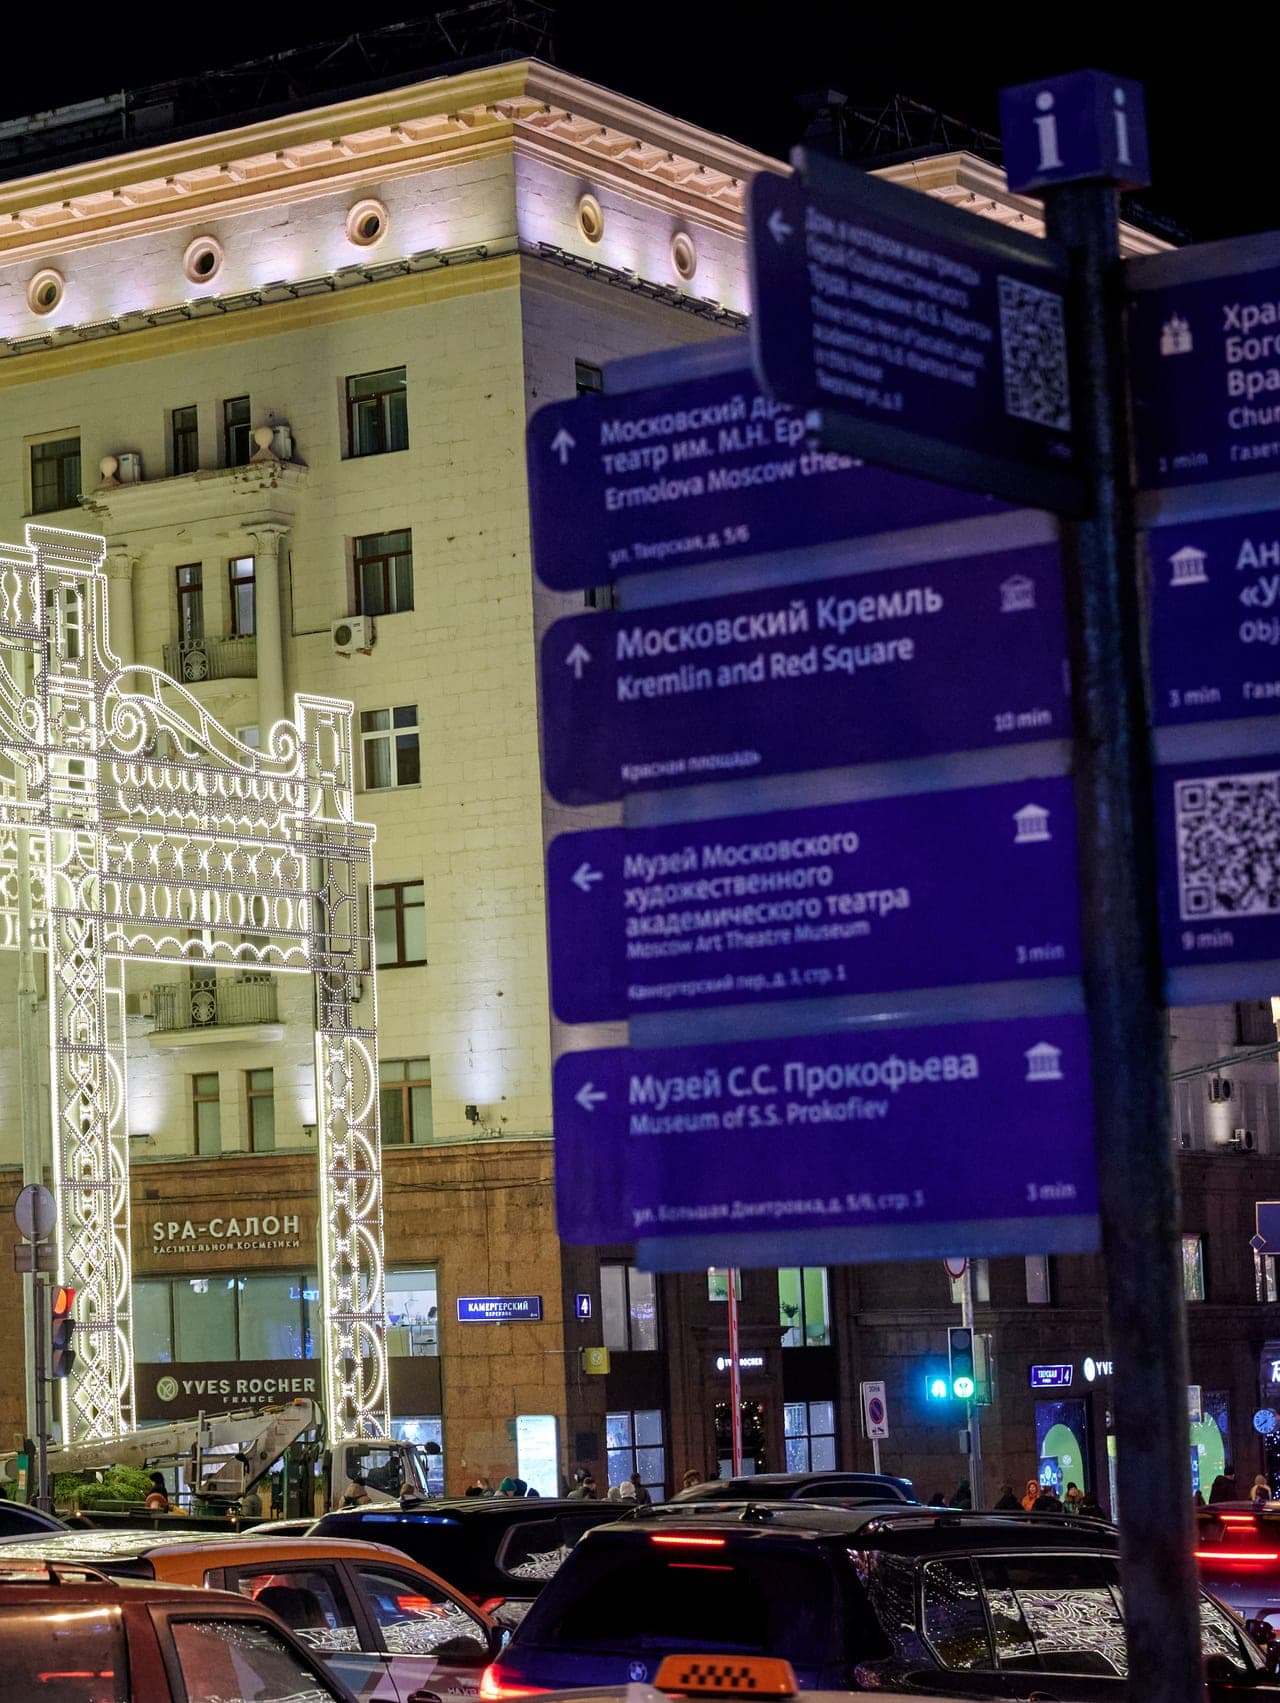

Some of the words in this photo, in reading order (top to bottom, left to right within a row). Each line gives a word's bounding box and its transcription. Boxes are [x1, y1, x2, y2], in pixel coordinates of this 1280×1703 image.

[1222, 301, 1280, 335] Хра
[600, 394, 746, 446] Московский
[602, 445, 668, 474] театр
[605, 476, 705, 511] Ermolova
[708, 459, 796, 492] Moscow
[616, 599, 809, 661] Московский
[816, 587, 944, 634] Кремль
[617, 664, 712, 702] Kremlin
[717, 654, 765, 687] and
[770, 646, 818, 680] Red
[822, 637, 914, 674] Square
[1017, 708, 1052, 729] min
[623, 847, 698, 883] Музей
[702, 831, 859, 870] Московского
[623, 865, 834, 914] художественного
[625, 897, 823, 938] академического
[826, 886, 911, 918] театра
[725, 926, 792, 950] Theatre
[794, 920, 870, 944] Museum
[629, 1068, 721, 1110] Музей
[727, 1064, 778, 1097] С.С.
[784, 1053, 979, 1098] Прокофьева
[629, 1108, 719, 1136] Museum
[722, 1104, 746, 1129] of
[748, 1104, 783, 1127] S.S.
[787, 1096, 888, 1125] Prokofiev
[1040, 1180, 1076, 1200] min
[153, 1215, 299, 1241] SPA-САЛОН
[237, 1240, 300, 1251] КОСМЕТИКИ
[468, 1300, 529, 1312] КАМЕРГЕРСКИЙ
[581, 1298, 588, 1314] 4
[1095, 1361, 1114, 1375] YVE
[182, 1380, 231, 1395] YVES
[236, 1377, 316, 1394] ROCHER
[223, 1396, 274, 1404] FRANCE
